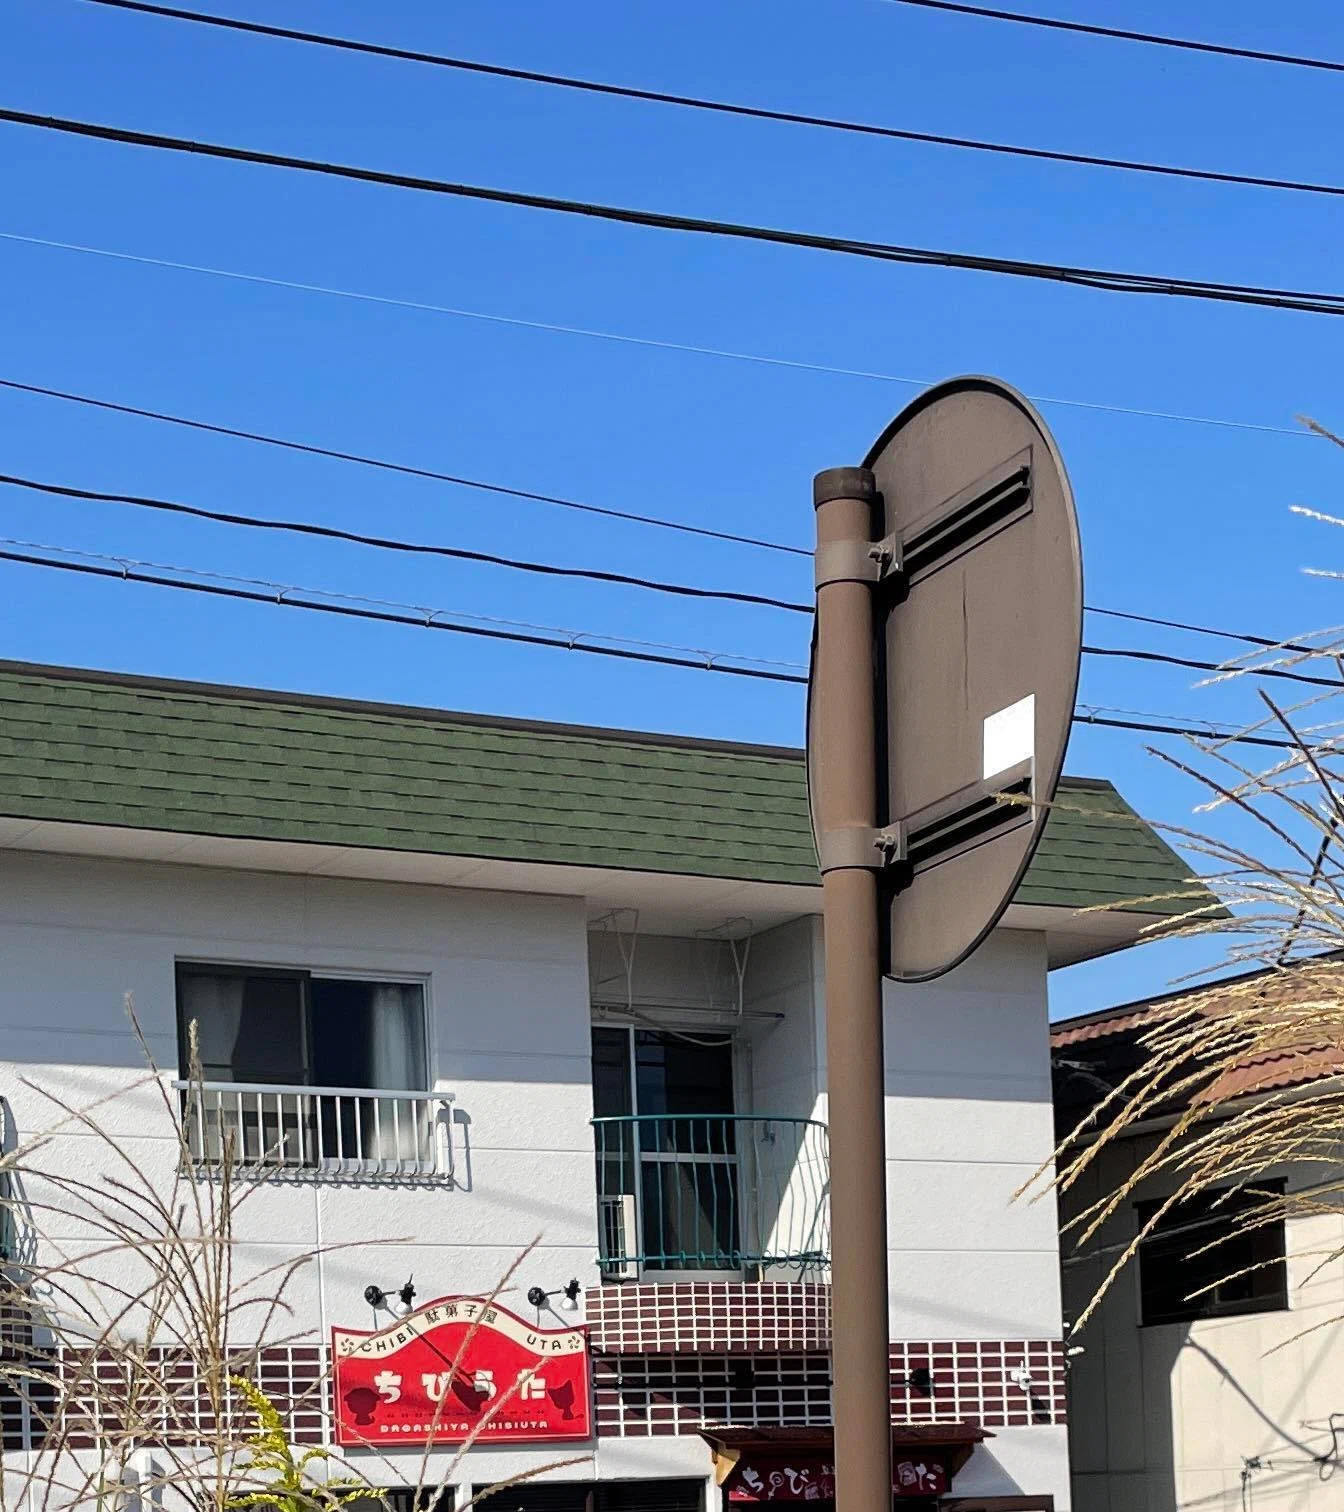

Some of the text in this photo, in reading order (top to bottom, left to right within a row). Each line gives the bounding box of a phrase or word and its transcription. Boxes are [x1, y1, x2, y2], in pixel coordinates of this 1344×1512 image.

[361, 1304, 562, 1353] CHIBI 駄菓子屋 UTA
